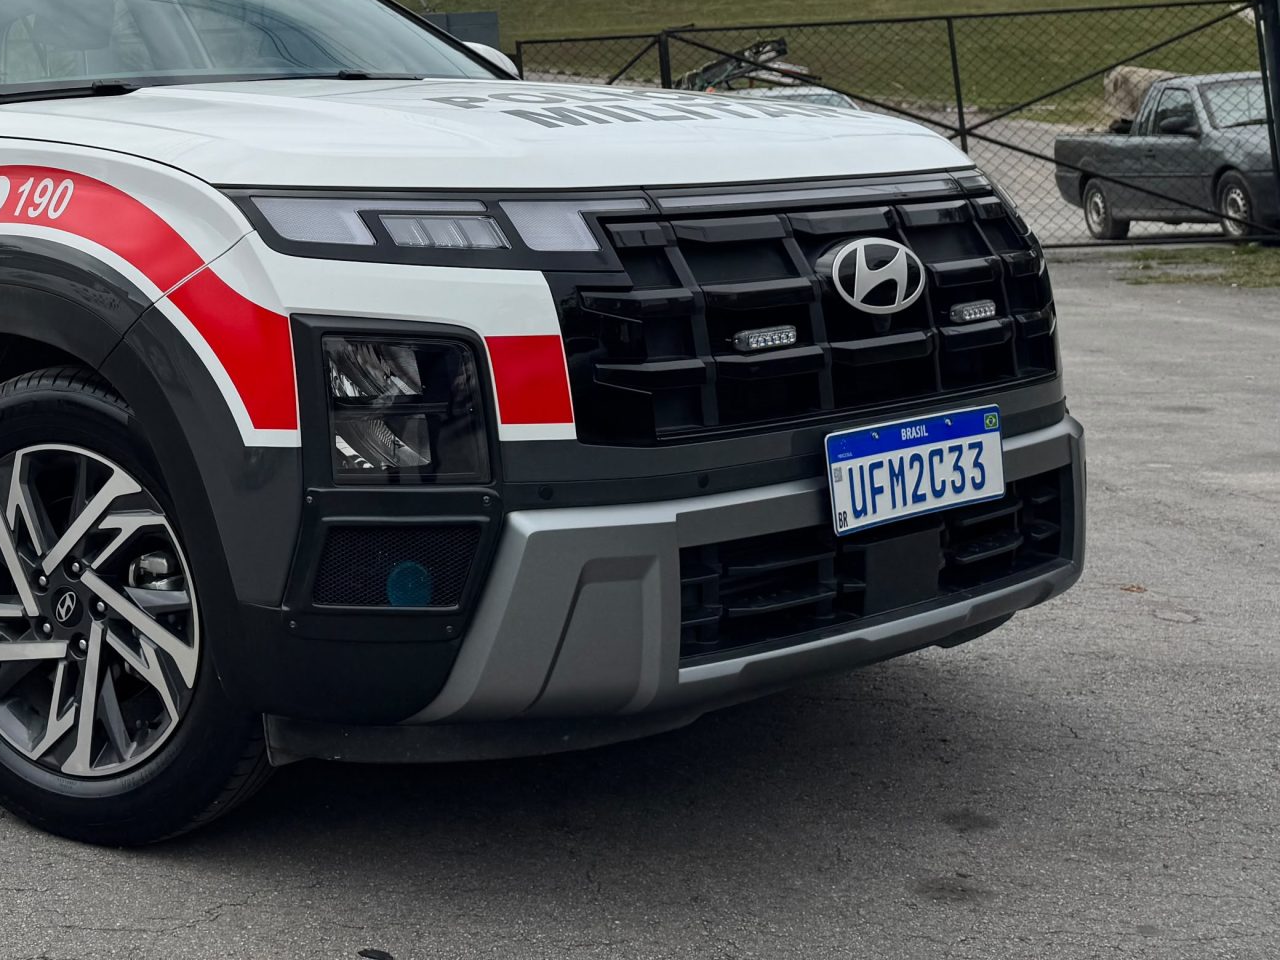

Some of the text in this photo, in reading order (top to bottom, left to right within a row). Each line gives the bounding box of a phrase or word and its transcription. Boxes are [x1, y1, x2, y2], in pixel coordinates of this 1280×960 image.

[501, 101, 873, 129] MILITAR
[14, 176, 75, 219] 190
[901, 424, 928, 441] BRASIL
[847, 440, 986, 519] UFM2C33
[837, 510, 849, 529] BR
